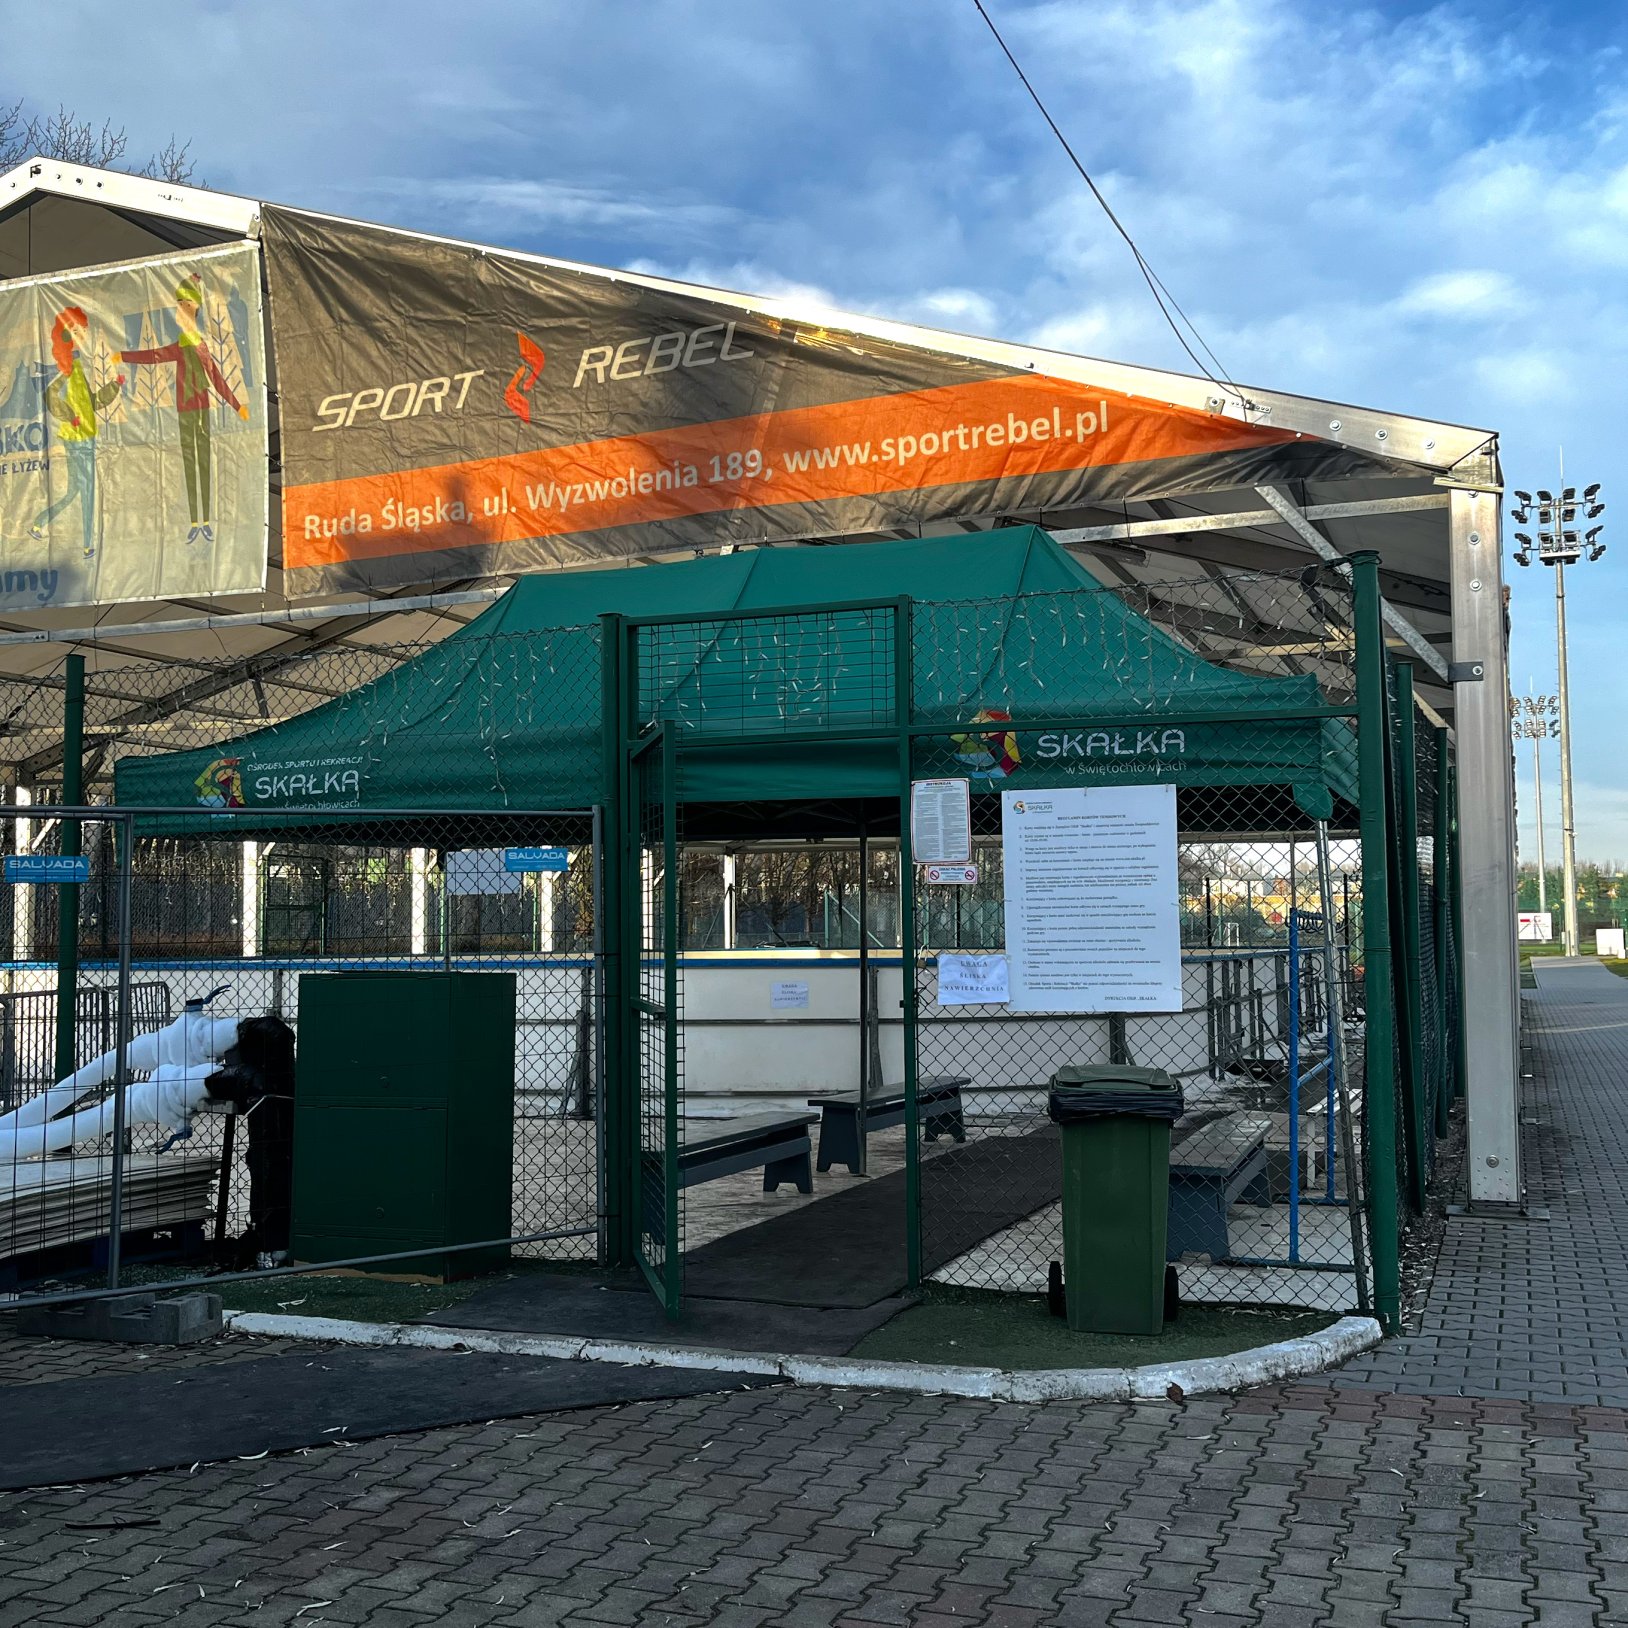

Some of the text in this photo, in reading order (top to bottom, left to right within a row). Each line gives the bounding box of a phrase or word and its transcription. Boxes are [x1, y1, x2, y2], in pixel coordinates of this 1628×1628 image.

[312, 322, 755, 432] SPORT REBEL
[0, 422, 49, 456] KO
[304, 401, 1108, 540] Ruda Śląska, ul. Wyzwolenia 189, www.sportrebel.pl
[0, 569, 58, 602] my
[1036, 729, 1185, 758] SKAŁKA
[284, 760, 316, 769] SPORTU
[255, 770, 360, 799] SKAŁKA
[9, 860, 84, 869] SALVADA
[508, 852, 566, 860] SALVADA
